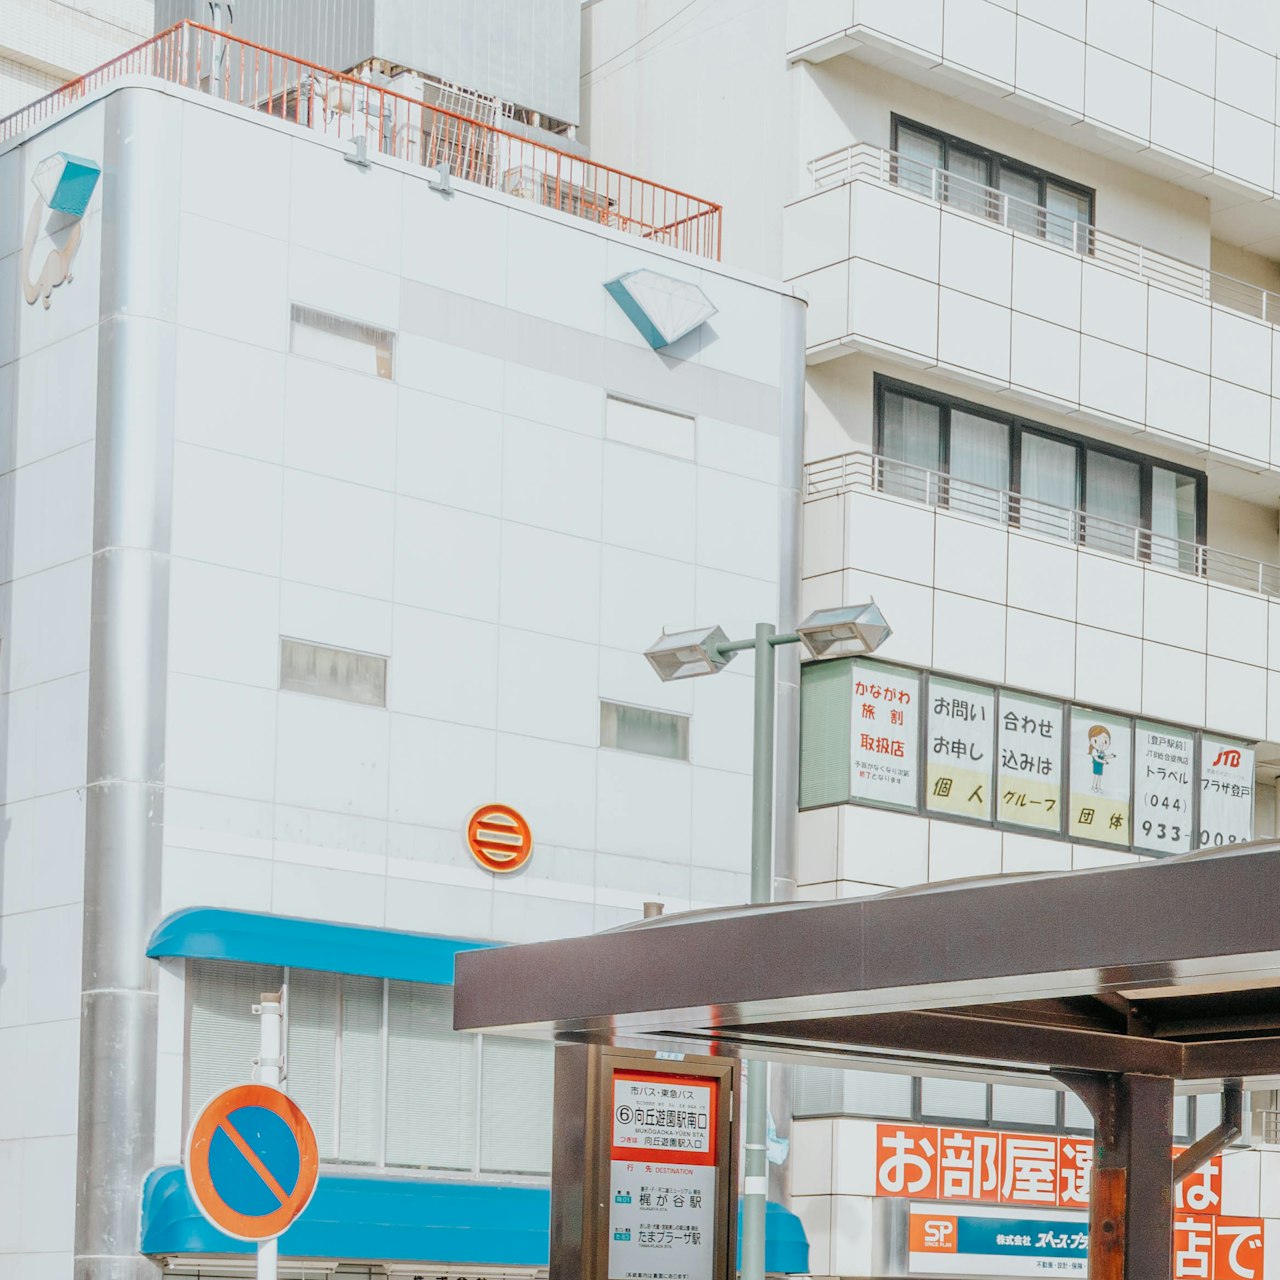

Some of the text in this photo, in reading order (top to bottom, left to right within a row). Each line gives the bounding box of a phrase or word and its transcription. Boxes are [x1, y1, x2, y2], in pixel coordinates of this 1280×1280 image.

[855, 681, 911, 705] かながわ
[860, 733, 905, 758] 取扱店
[1212, 749, 1241, 768] JTB
[639, 1193, 702, 1209] 梶が谷駅
[924, 1220, 954, 1242] SP
[996, 1233, 1031, 1246] 株式会社
